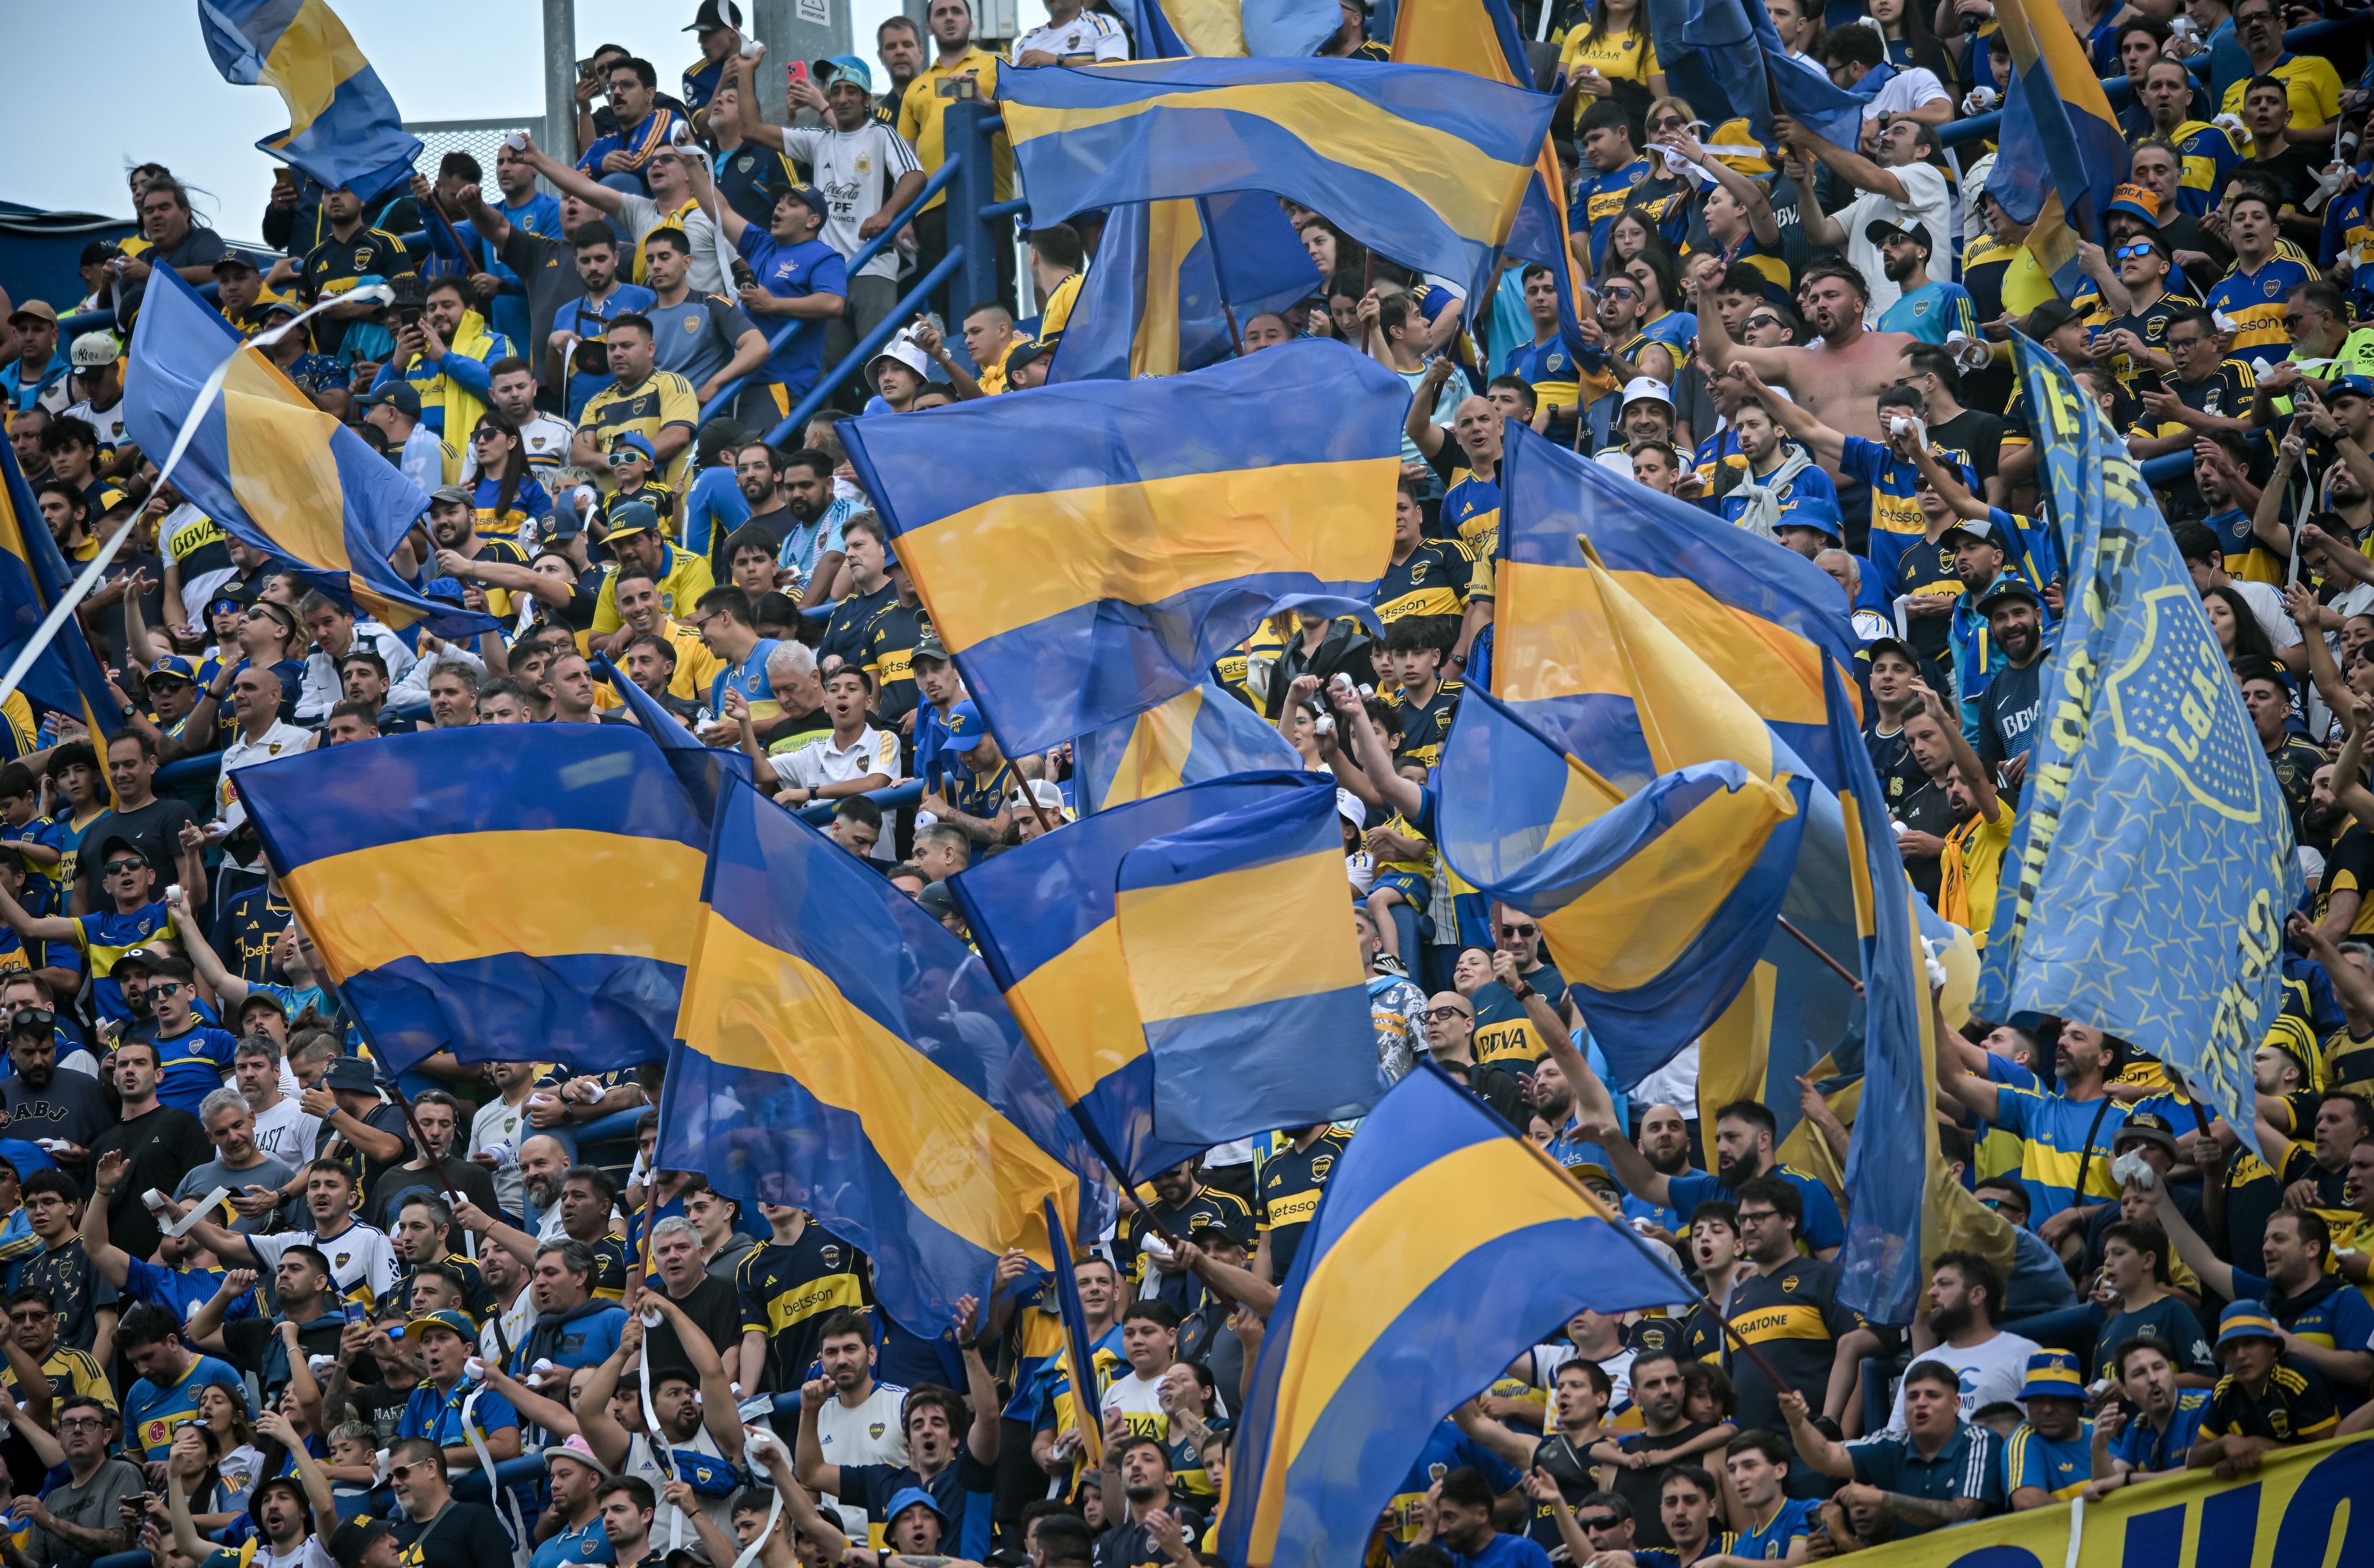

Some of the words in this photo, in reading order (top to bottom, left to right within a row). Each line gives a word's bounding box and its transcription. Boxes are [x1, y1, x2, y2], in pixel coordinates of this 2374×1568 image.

[801, 9, 826, 21] ATENCIÓN
[611, 520, 625, 531] CABJ
[1878, 506, 1925, 524] etsso
[173, 520, 219, 557] BBVA
[1270, 1200, 1320, 1221] etsso
[783, 1288, 833, 1316] betsson
[1732, 1315, 1788, 1336] EGATONE
